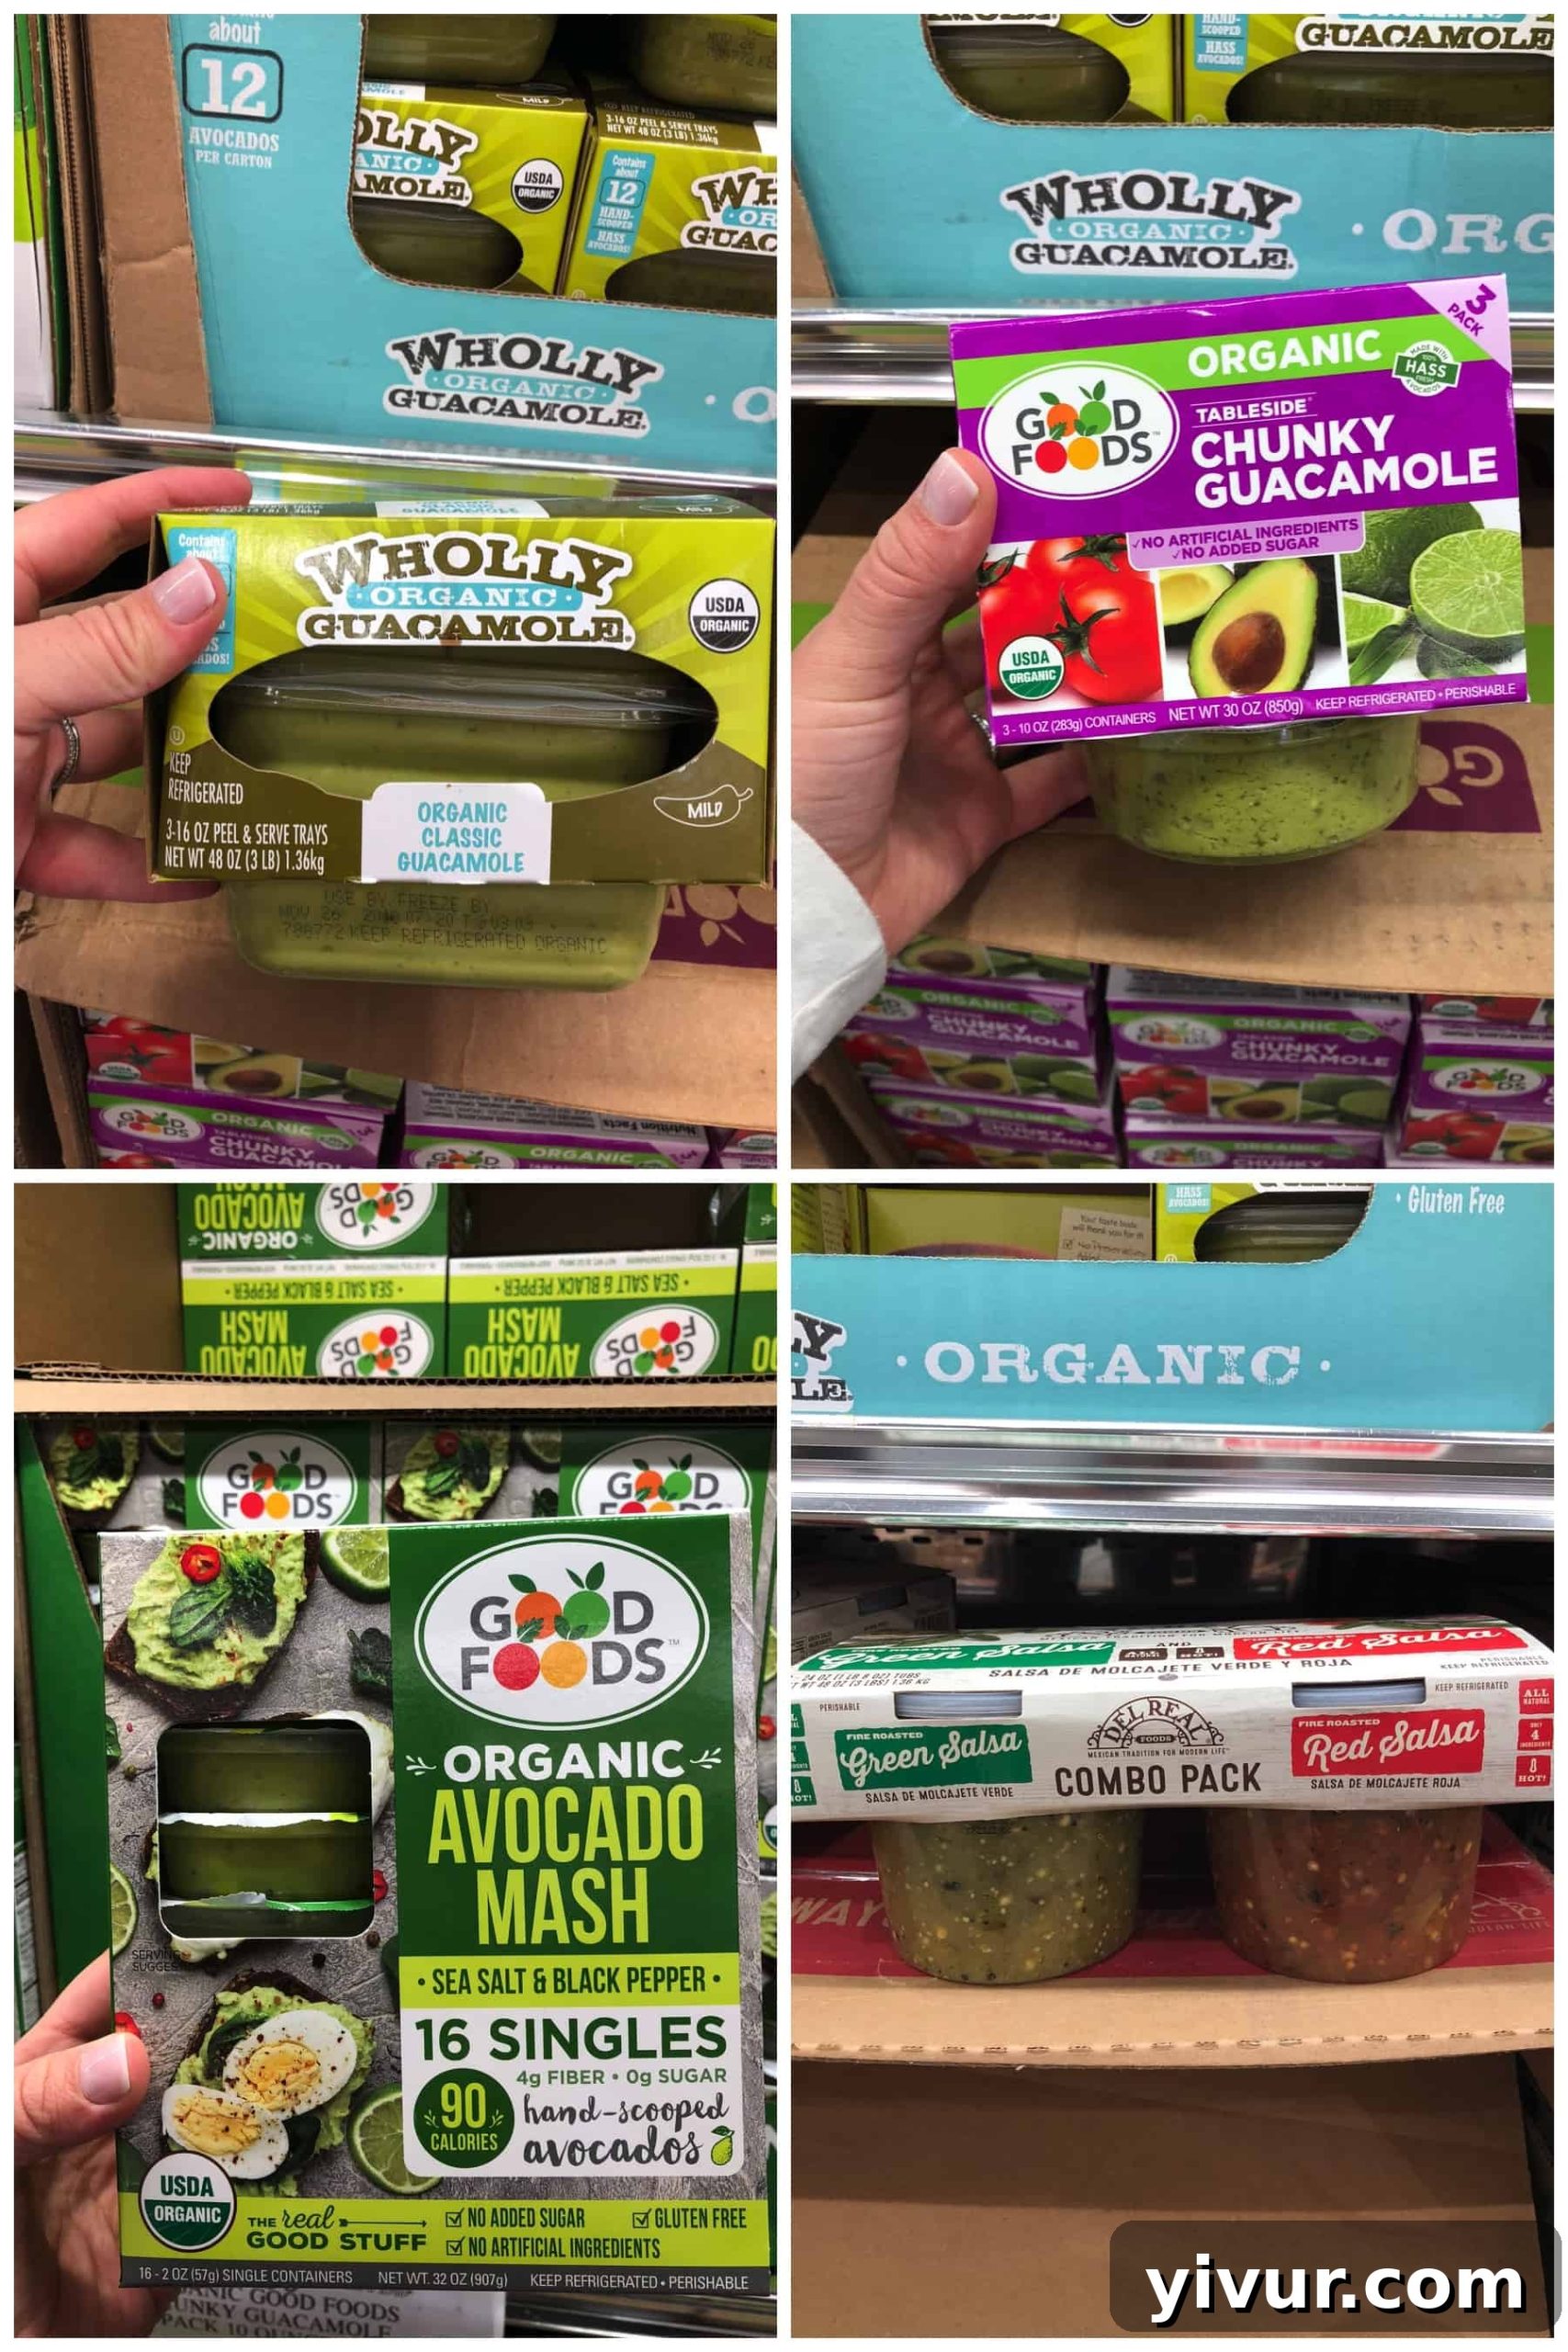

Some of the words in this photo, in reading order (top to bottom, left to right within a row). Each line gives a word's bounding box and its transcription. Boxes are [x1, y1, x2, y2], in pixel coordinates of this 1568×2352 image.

[209, 17, 261, 45] about
[1204, 40, 1236, 55] HASS
[200, 58, 267, 119] 12
[188, 126, 280, 152] AVOCADOS
[194, 148, 220, 164] PER
[524, 171, 553, 185] USDA
[604, 179, 638, 204] 12
[1007, 174, 1293, 231] WHOLLY
[1067, 220, 1233, 242] ORGANIC
[1014, 243, 1291, 271] GUACAMOLE
[1446, 301, 1485, 337] PACK
[391, 332, 658, 395] WHOLLY
[1187, 328, 1383, 379] ORGANIC
[1404, 358, 1449, 379] HASS
[443, 374, 597, 402] ORGANIC
[388, 389, 645, 431] GUACAMOLE
[1015, 399, 1143, 441] GOOD
[1195, 398, 1308, 424] TABLESIDE
[1011, 430, 1154, 476] FOODS
[1190, 414, 1396, 469] CHUNKY
[1194, 445, 1499, 509] GUACAMOLE
[1140, 536, 1165, 549] NO
[1168, 530, 1253, 547] ARTIFICIAL
[1256, 517, 1359, 540] INGREDIENTS
[1181, 546, 1205, 560] NO
[1208, 540, 1263, 558] ADDED
[1264, 536, 1320, 553] SUGAR
[303, 537, 625, 597] WHOLLY
[369, 586, 557, 607] ORGANIC
[705, 596, 746, 614] USDA
[304, 613, 625, 642] GUACAMOLE
[699, 618, 750, 633] ORGANIC
[1011, 649, 1051, 667] USDA
[1009, 668, 1057, 684] ORGANIC
[1018, 721, 1032, 735] 10
[1032, 719, 1050, 734] OZ
[1084, 710, 1157, 729] CONTAINERS
[1168, 706, 1196, 723] NET
[1197, 704, 1221, 720] WT
[1223, 702, 1239, 718] 30
[1241, 700, 1262, 717] OZ
[1264, 697, 1304, 718] (850g)
[1314, 697, 1348, 712] KEEP
[1348, 689, 1437, 709] REFRIGERATED
[1444, 682, 1517, 701] PERISHABLE
[168, 751, 192, 775] KEEP
[167, 778, 244, 806] REFRIGERATED
[416, 801, 508, 824] ORGANIC
[686, 801, 724, 820] MILD
[164, 817, 190, 843] 3-16
[193, 820, 209, 844] OZ
[212, 821, 240, 845] PEEL
[242, 824, 253, 844] &
[254, 823, 290, 846] SERVE
[292, 822, 329, 847] TRAYS
[420, 826, 503, 849] CLASSIC
[164, 844, 186, 868] NET
[186, 846, 206, 869] WT
[207, 847, 223, 869] 48
[225, 847, 243, 870] OZ
[243, 848, 260, 873] (3
[261, 848, 282, 874] LB)
[284, 847, 325, 876] 1.36kg
[396, 851, 525, 874] GUACAMOLE
[1233, 1017, 1338, 1033] ORGANIC
[1231, 1040, 1340, 1054] CHUNKY
[1231, 1050, 1390, 1069] GUACAMOLE
[211, 1112, 313, 1137] ORGANIC
[209, 1135, 315, 1160] CHUNKY
[194, 1192, 306, 1231] AVOCADO
[1407, 1184, 1463, 1214] Gluten
[1468, 1185, 1506, 1215] Free
[202, 1230, 299, 1251] ORGANIC
[220, 1309, 288, 1345] MASH
[487, 1306, 562, 1344] MASH
[923, 1340, 1303, 1386] ORGANIC
[468, 1589, 655, 1643] GOOD
[1359, 1629, 1505, 1651] Salsa
[459, 1636, 667, 1691] FOODS
[987, 1668, 1050, 1679] SALSA
[1058, 1667, 1082, 1677] DE
[1090, 1663, 1202, 1675] MOLCAJETE
[1210, 1660, 1273, 1671] VERDE
[1280, 1659, 1292, 1669] Y
[1300, 1657, 1353, 1668] ROJA
[1434, 1681, 1454, 1692] KEEP
[1522, 1688, 1551, 1698] ALL
[1102, 1704, 1145, 1744] DEL
[1147, 1699, 1209, 1741] REAL
[1297, 1719, 1325, 1728] FIRE
[1325, 1717, 1382, 1727] ROASTED
[1529, 1728, 1540, 1741] 4
[846, 1733, 872, 1741] FIRE
[873, 1731, 924, 1740] ROASTED
[1303, 1730, 1374, 1773] Red
[1378, 1718, 1481, 1765] Salsa
[443, 1739, 686, 1783] ORGANIC
[839, 1744, 935, 1788] Green
[938, 1729, 1022, 1770] Salsa
[1054, 1763, 1168, 1798] COMBO
[1179, 1761, 1262, 1794] PACK
[1310, 1778, 1345, 1791] SALSA
[1348, 1778, 1362, 1790] DE
[1365, 1777, 1429, 1790] MOLCAJETE
[1431, 1776, 1461, 1789] ROJA
[864, 1792, 899, 1804] SALSA
[901, 1790, 916, 1802] DE
[919, 1787, 980, 1802] MOLCAJETE
[981, 1786, 1014, 1799] VERDE
[427, 1783, 704, 1864] AVOCADO
[476, 1866, 649, 1946] MASH
[432, 1968, 472, 1995] SEA
[477, 1967, 527, 1995] SALT
[533, 1967, 547, 1995] &
[552, 1966, 621, 1995] BLACK
[626, 1964, 706, 1994] PEPPER
[414, 2018, 471, 2062] 16
[488, 2015, 728, 2061] SINGLES
[515, 2069, 541, 2088] 4g
[547, 2068, 606, 2086] FIBER
[658, 2067, 728, 2085] SUGAR
[439, 2081, 488, 2130] 90
[523, 2091, 730, 2133] hand-scooped
[430, 2132, 499, 2153] CALORIES
[522, 2124, 704, 2167] avocados
[160, 2174, 215, 2198] USDA
[153, 2204, 222, 2224] ORGANIC
[247, 2216, 276, 2228] THE
[281, 2204, 335, 2231] real
[467, 2207, 487, 2229] NO
[490, 2206, 536, 2229] ADDED
[538, 2206, 586, 2229] SUGAR
[653, 2206, 708, 2230] GLUTEN
[712, 2207, 748, 2230] FREE
[245, 2231, 329, 2250] GOOD
[339, 2232, 427, 2252] STUFF
[467, 2235, 488, 2257] NO
[490, 2236, 566, 2259] ARTIFICIAL
[569, 2236, 661, 2260] INGREDIENTS
[171, 2267, 189, 2281] OZ
[221, 2268, 268, 2283] SINGLE
[270, 2269, 354, 2285] CONTAINERS
[378, 2270, 404, 2285] NET
[432, 2271, 448, 2286] 32
[449, 2271, 468, 2287] OZ
[529, 2273, 562, 2288] KEEP
[564, 2273, 659, 2290] REFRIGERATED
[668, 2275, 749, 2290] PERISHABLE
[322, 2296, 400, 2324] FOODS
